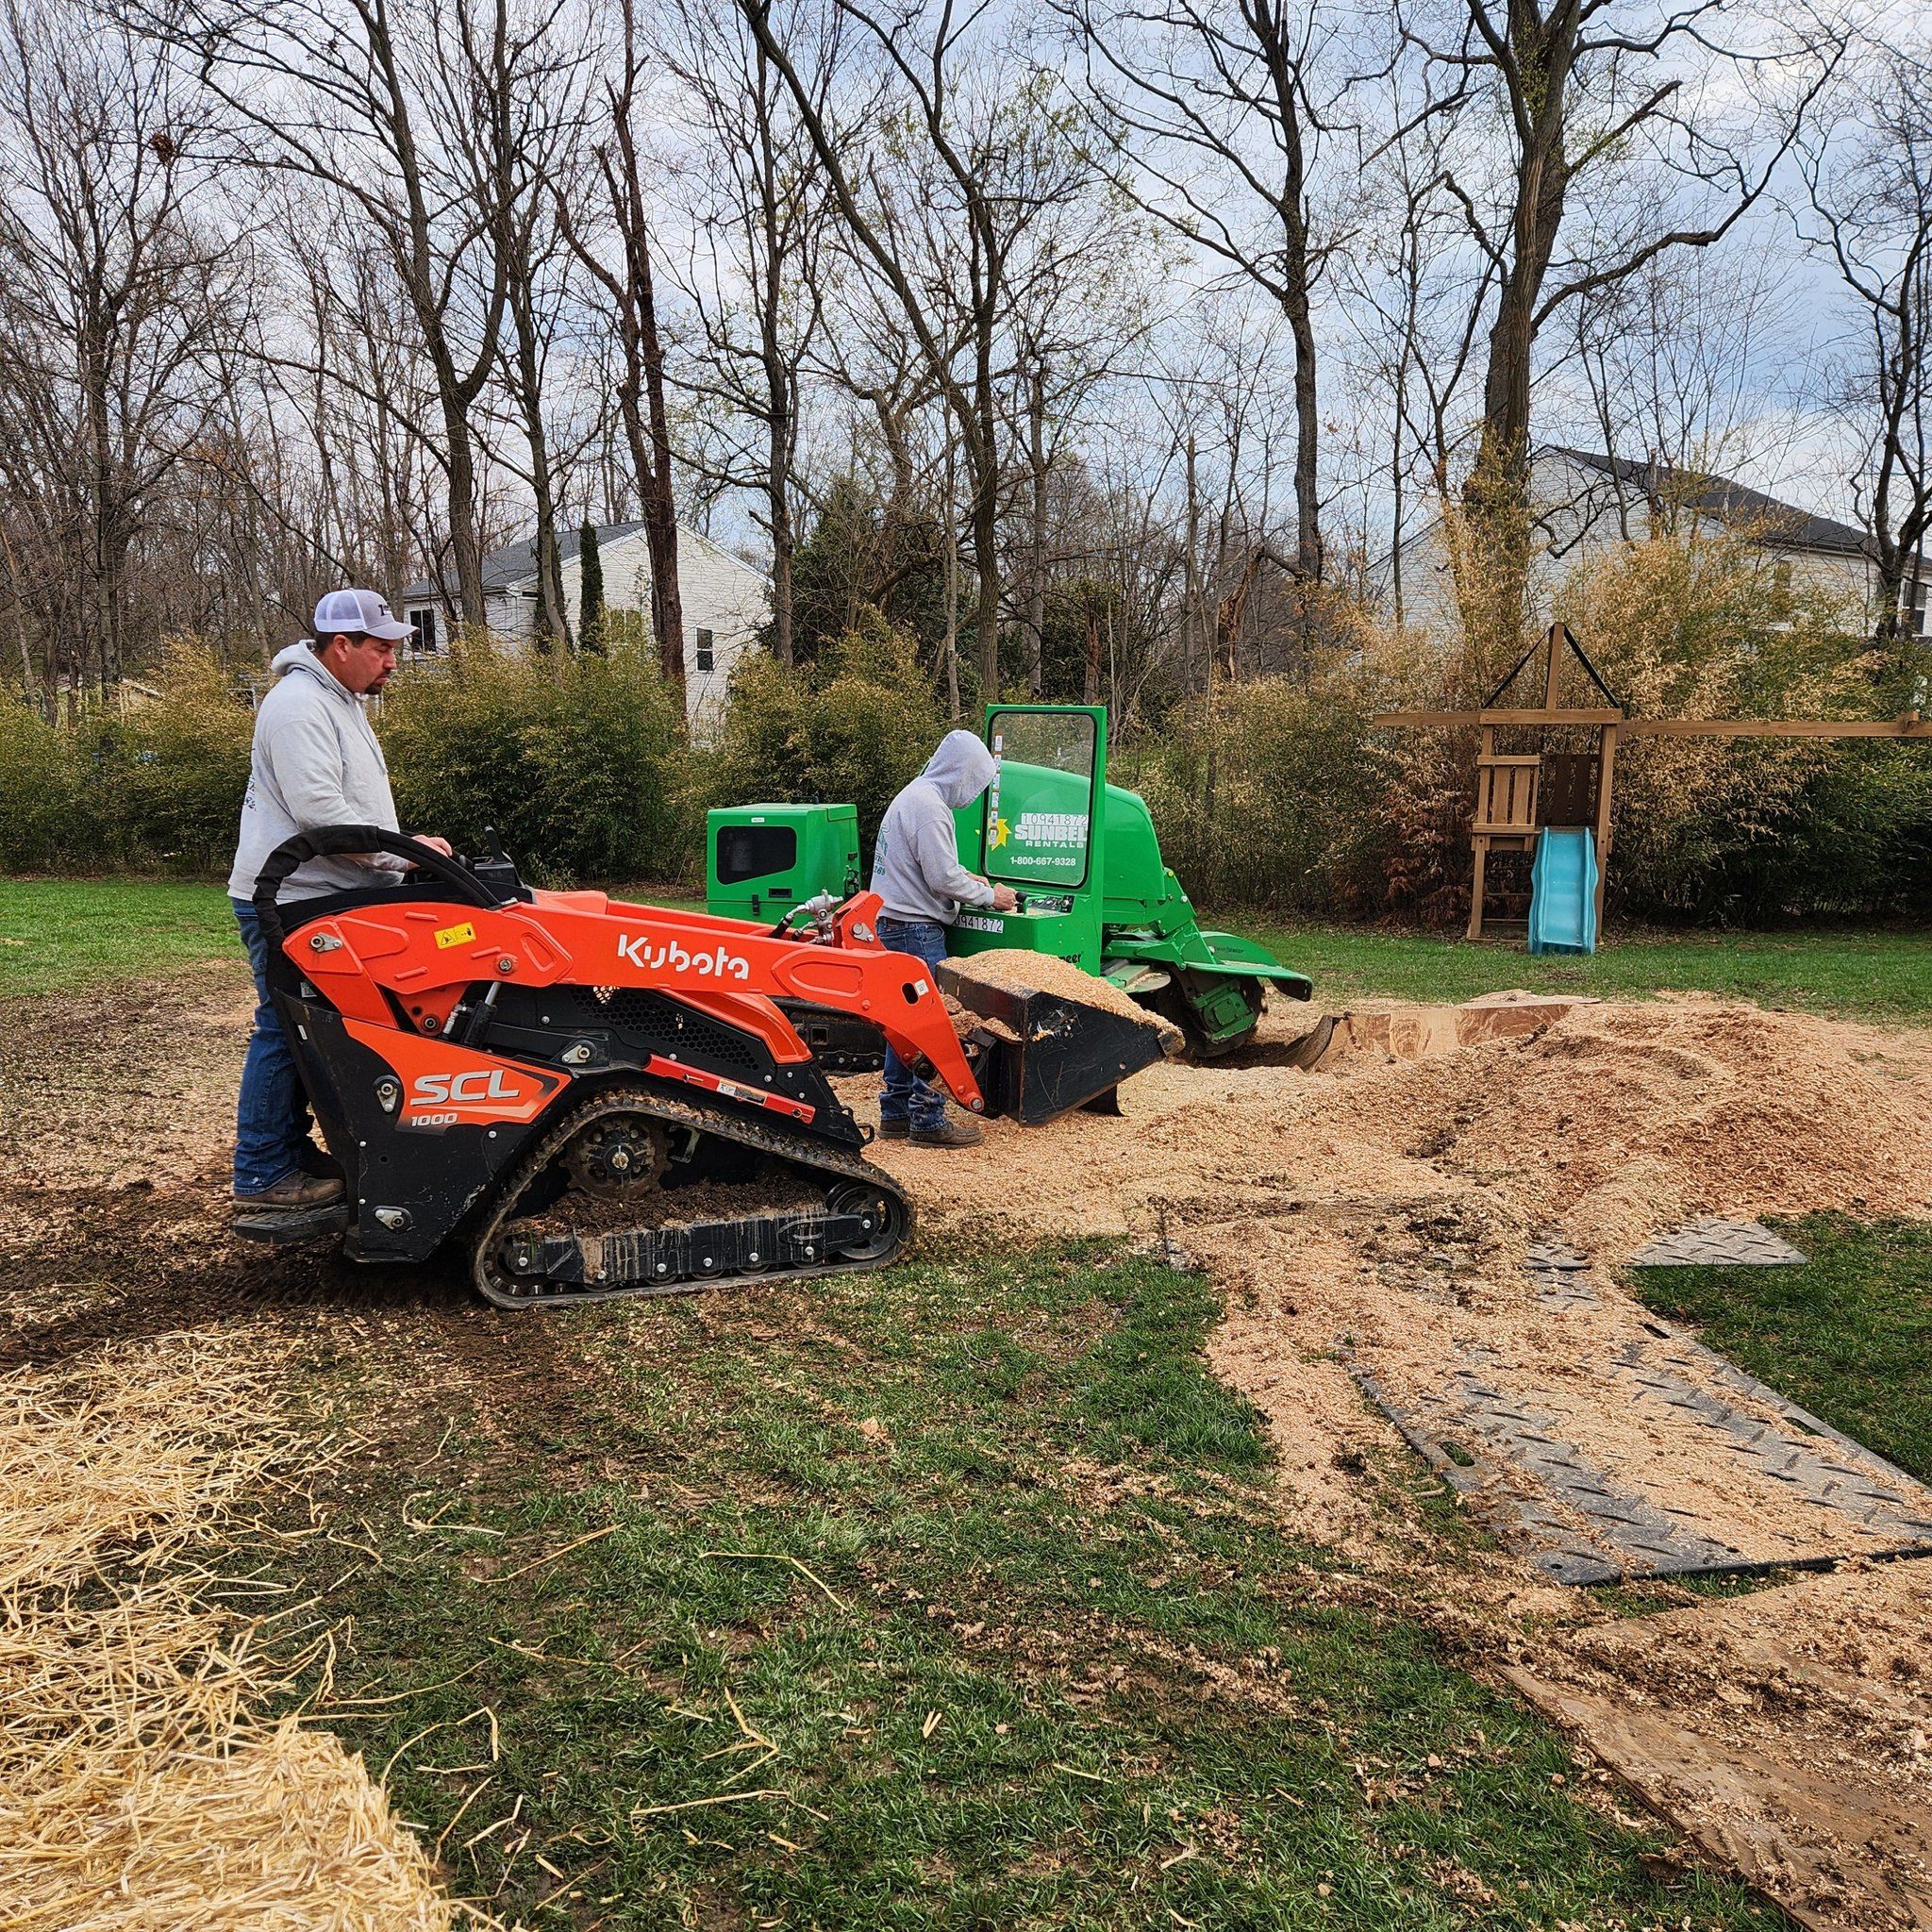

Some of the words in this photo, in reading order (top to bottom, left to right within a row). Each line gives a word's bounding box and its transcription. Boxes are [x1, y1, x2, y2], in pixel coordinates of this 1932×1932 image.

[1023, 813, 1088, 825] 10941872
[1014, 824, 1088, 841] SUNBEL
[1010, 857, 1076, 866] 1-800-667-9328
[954, 915, 1003, 932] 0941872
[617, 934, 750, 979] Kubota
[409, 1070, 520, 1106] SCL
[411, 1113, 458, 1126] 1000
